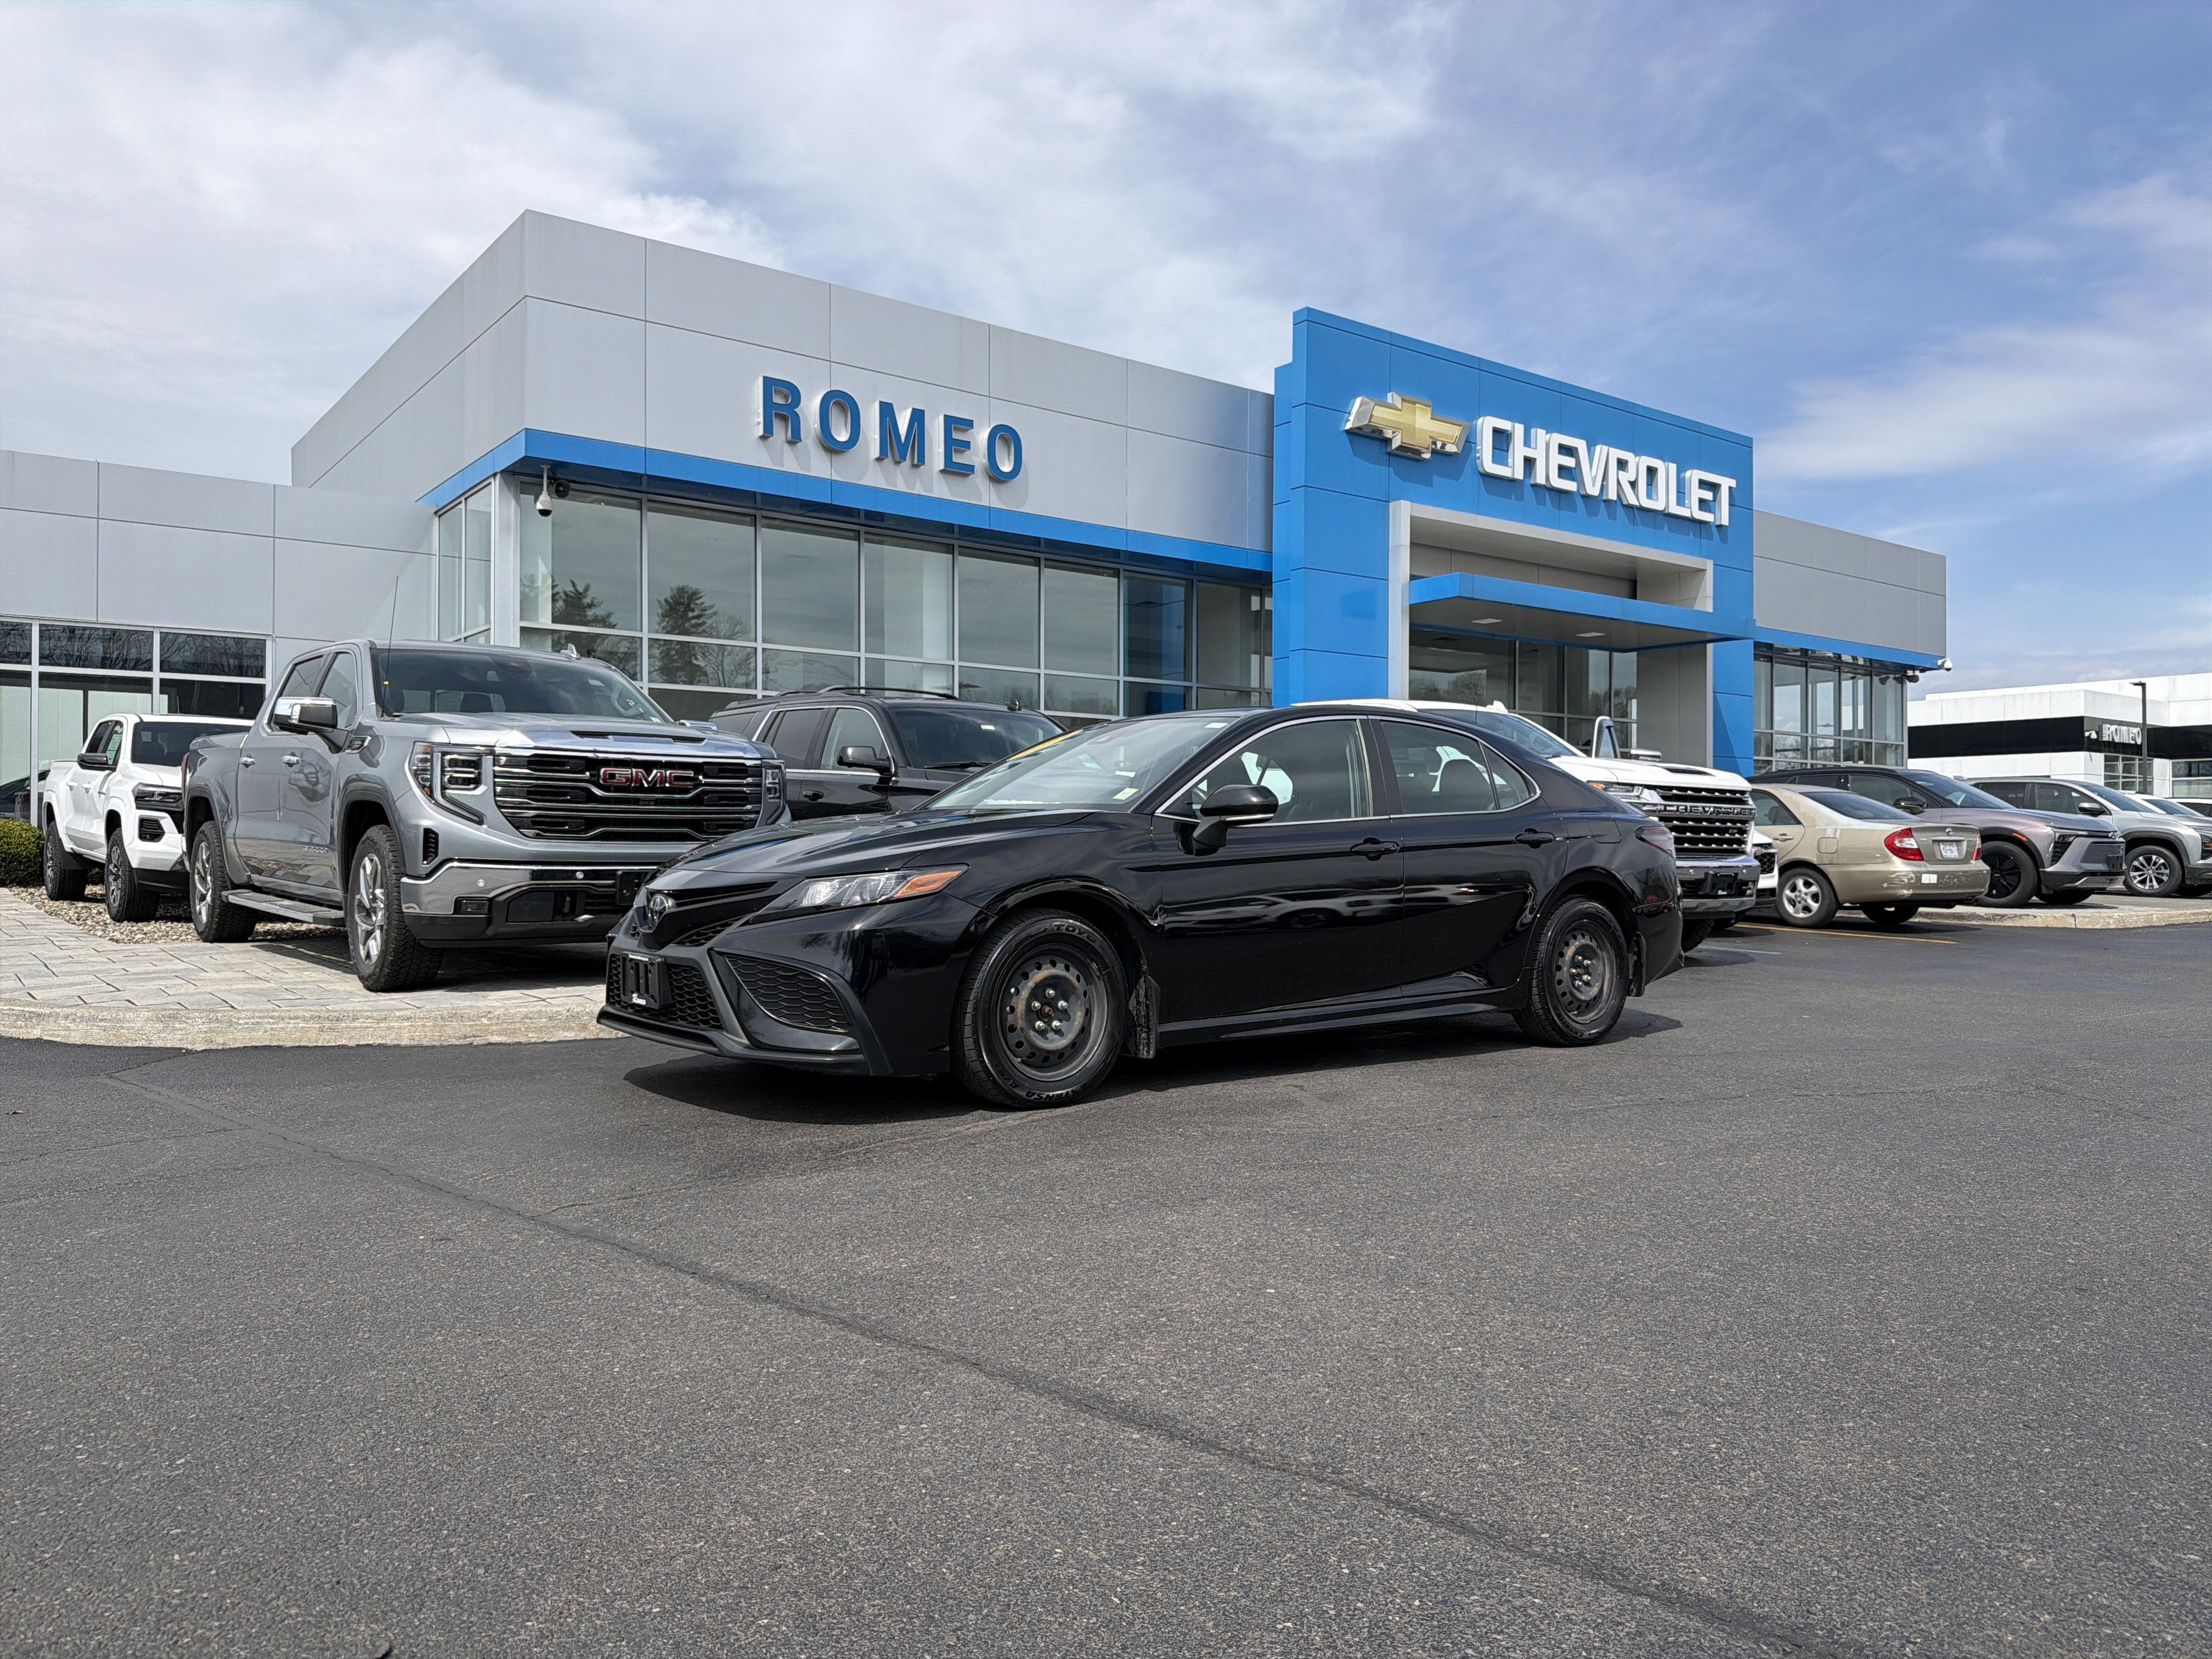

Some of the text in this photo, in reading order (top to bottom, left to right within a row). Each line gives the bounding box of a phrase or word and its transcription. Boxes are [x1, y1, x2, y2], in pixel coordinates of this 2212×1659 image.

[758, 375, 1023, 482] ROMEO
[1476, 415, 1736, 527] CHEVROLET
[2102, 724, 2142, 745] ROMEO
[600, 768, 695, 788] GMC
[1662, 805, 1755, 816] CHEVROLET
[1053, 923, 1097, 943] TOYO
